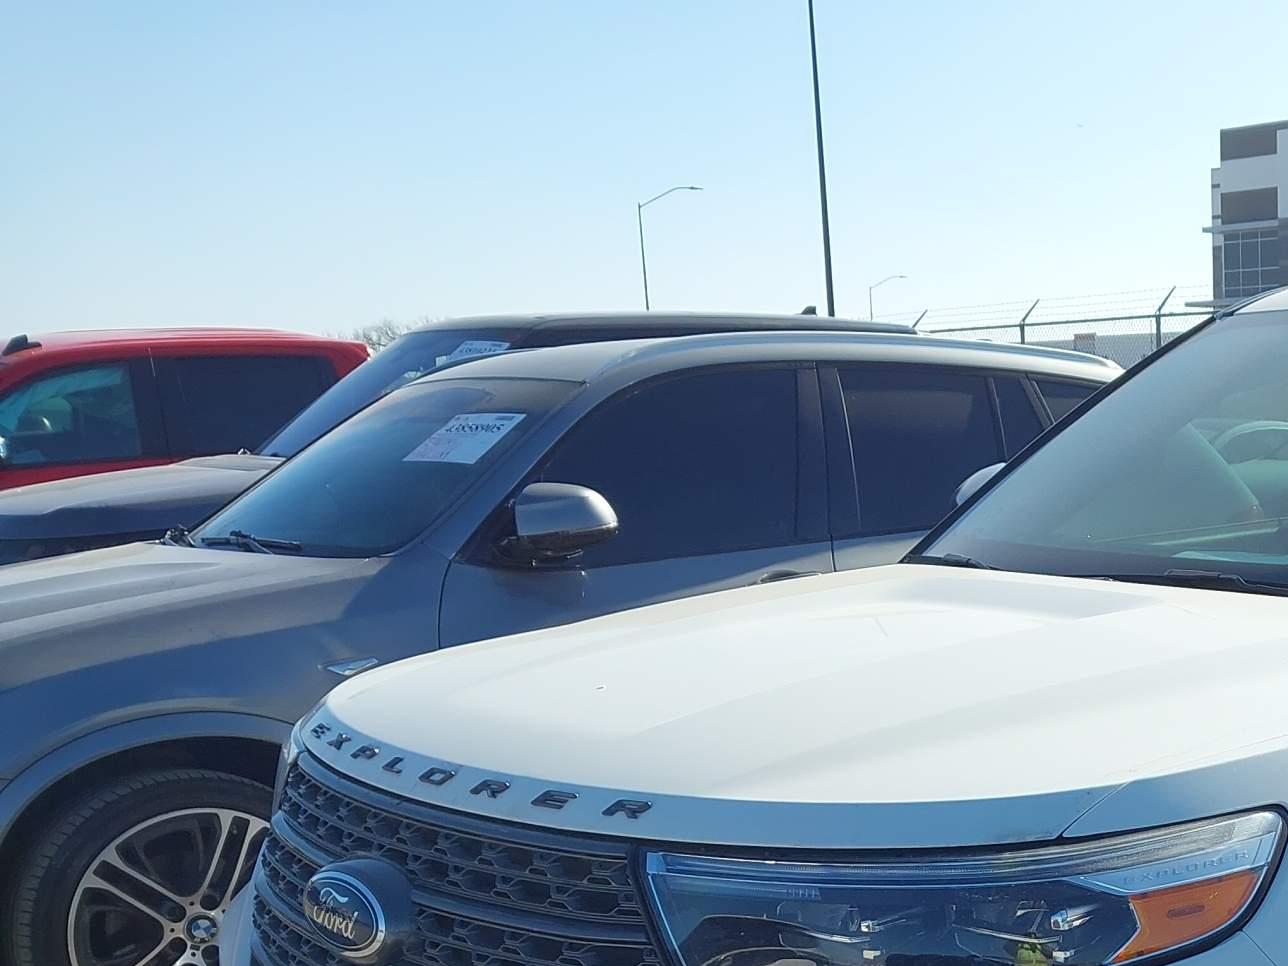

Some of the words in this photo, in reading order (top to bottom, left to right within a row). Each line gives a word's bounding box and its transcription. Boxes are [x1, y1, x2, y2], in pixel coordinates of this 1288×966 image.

[310, 722, 653, 819] EXPLORER
[1123, 850, 1249, 885] EXPLORER
[312, 887, 359, 940] Ford
